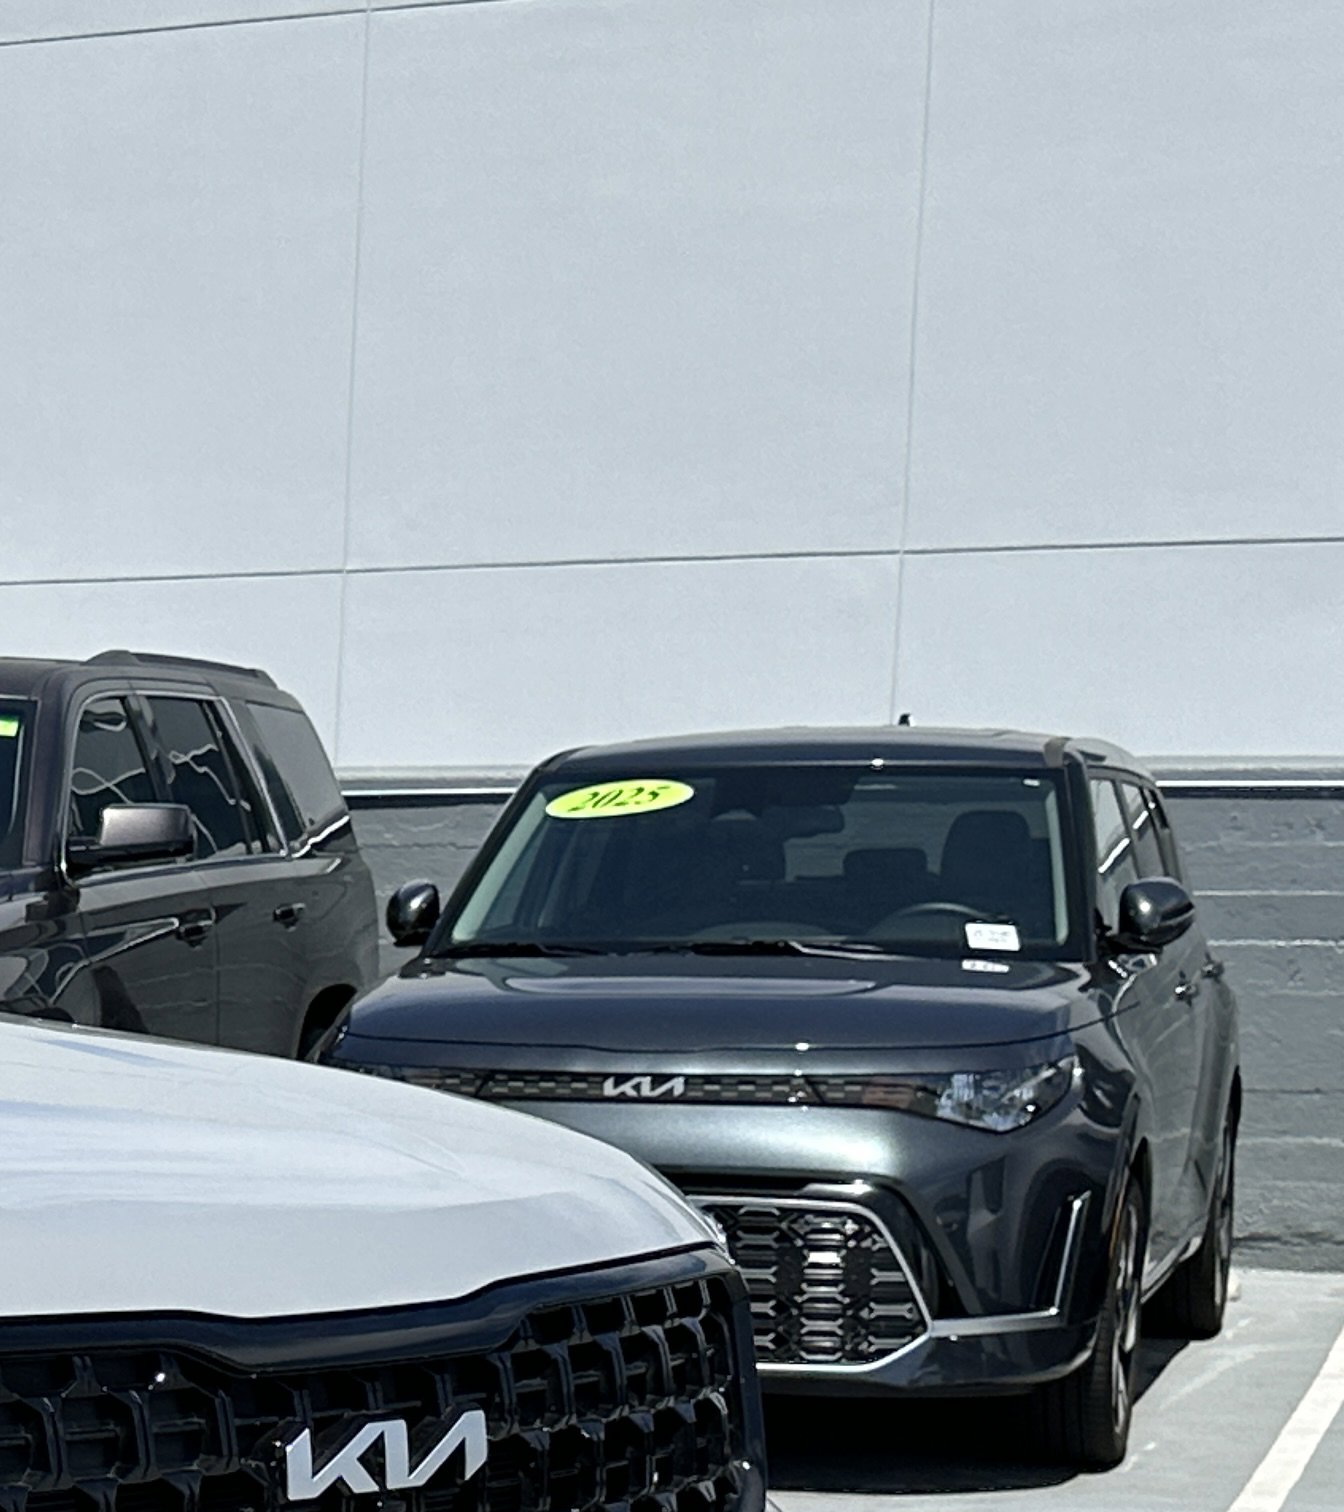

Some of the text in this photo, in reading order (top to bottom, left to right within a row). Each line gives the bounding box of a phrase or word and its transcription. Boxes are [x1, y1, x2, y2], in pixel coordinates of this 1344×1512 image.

[567, 785, 670, 812] 2025
[603, 1075, 685, 1097] KIA
[285, 1409, 489, 1501] KIA
